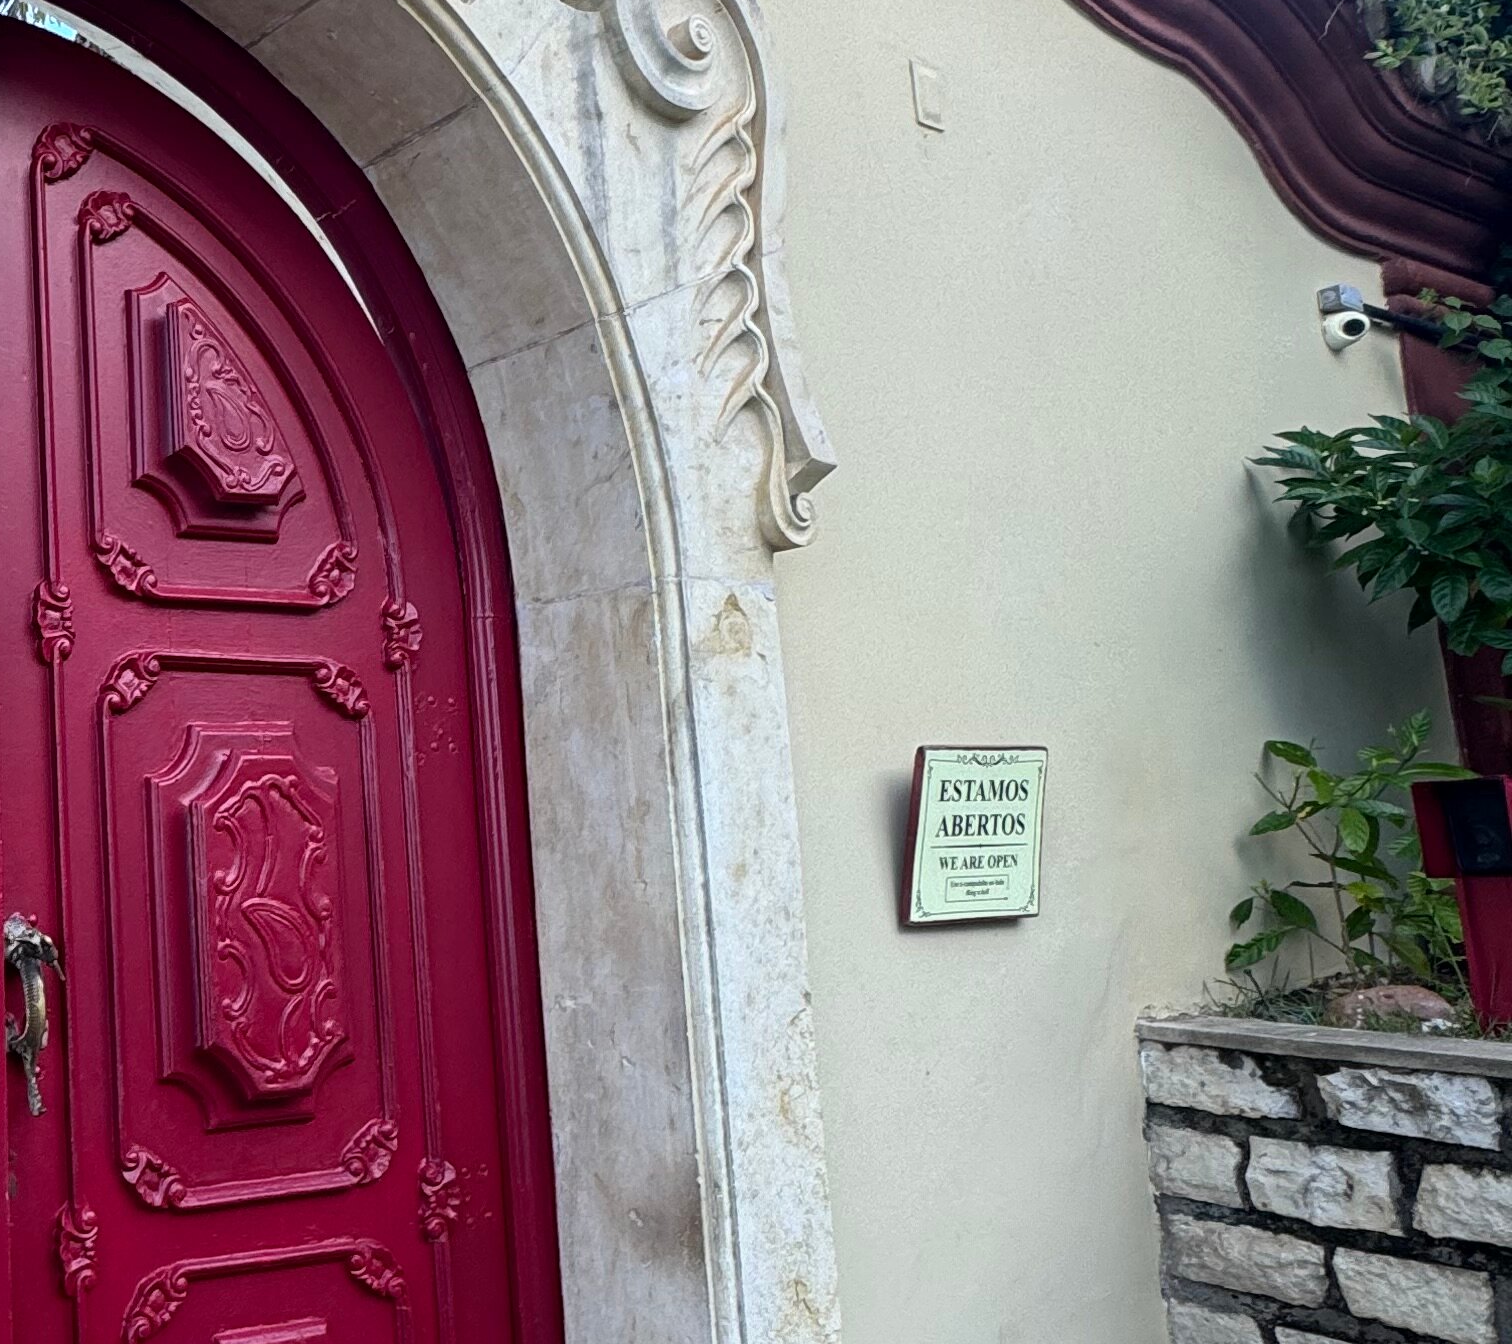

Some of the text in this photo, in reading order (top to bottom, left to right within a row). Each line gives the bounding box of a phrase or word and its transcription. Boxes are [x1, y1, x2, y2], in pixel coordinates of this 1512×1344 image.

[938, 779, 1029, 802] ESTAMOS
[935, 813, 1026, 837] ABERTOS
[939, 854, 1018, 870] WE ARE OPEN
